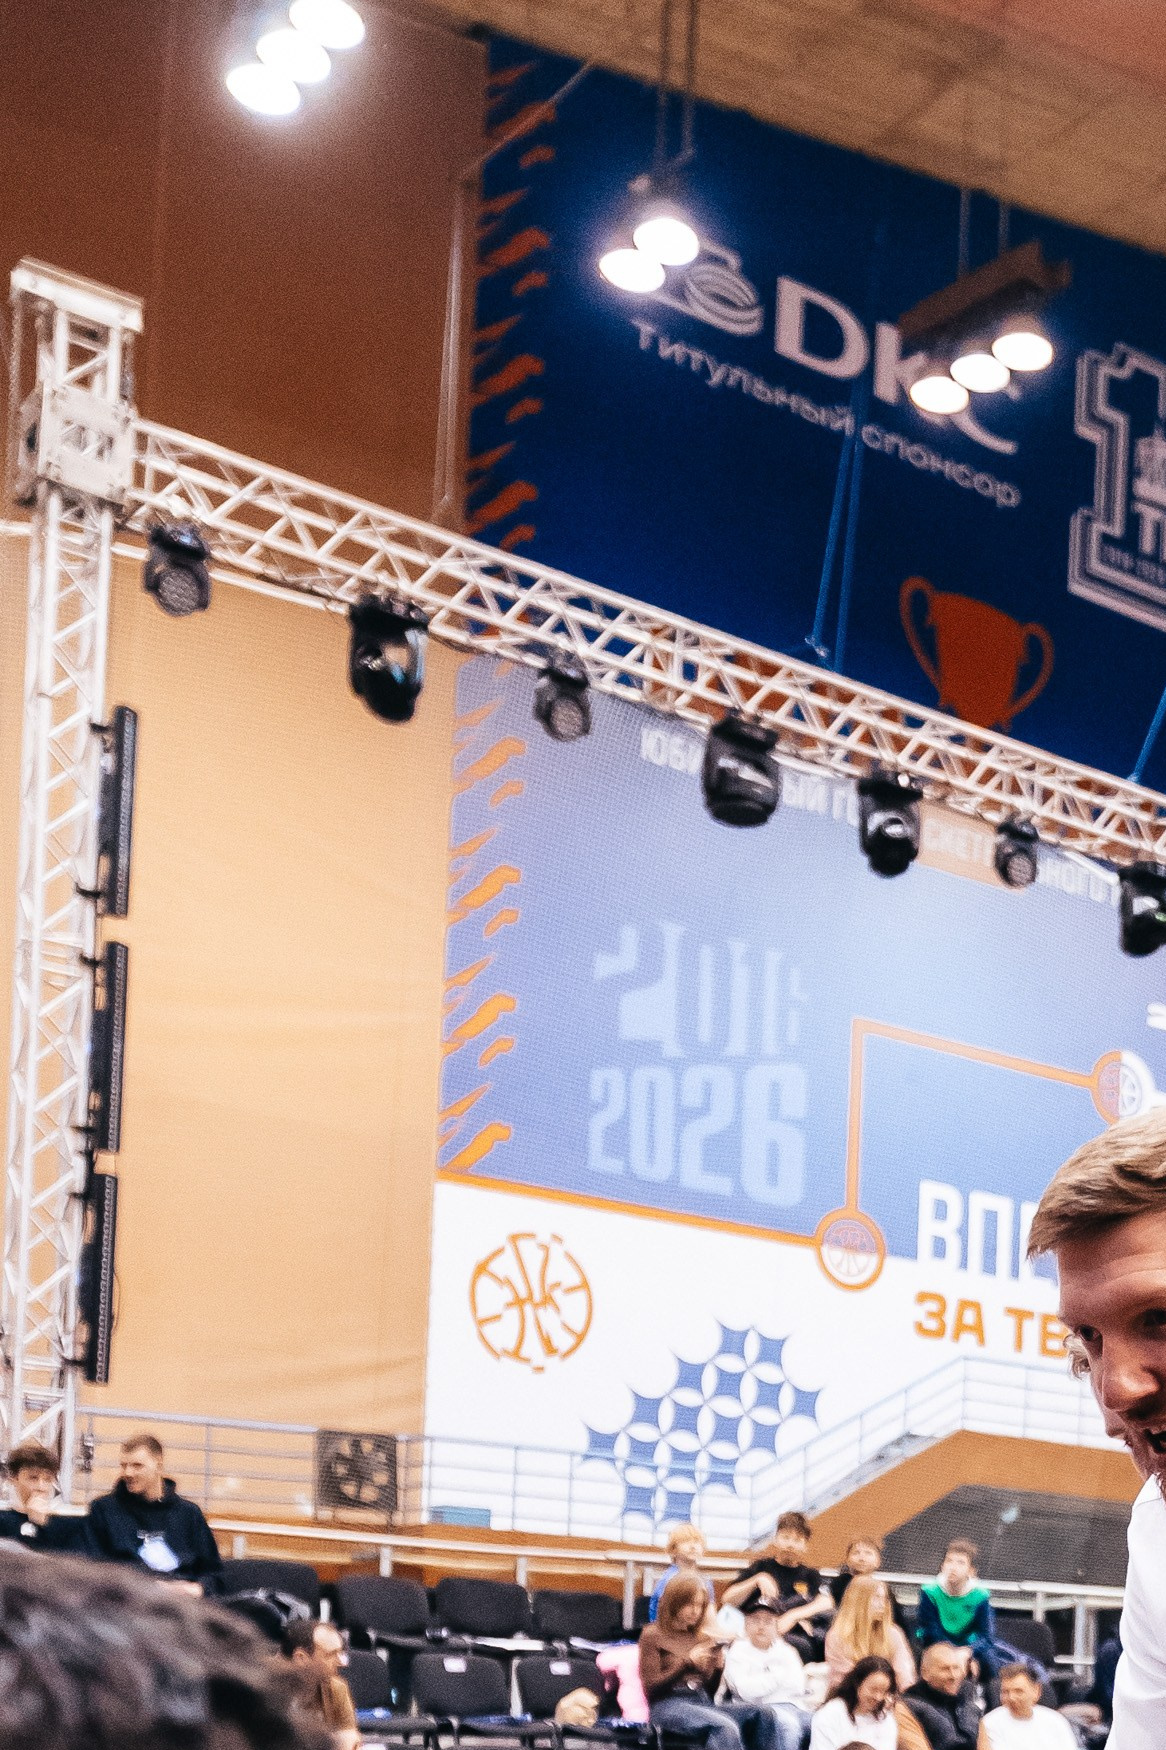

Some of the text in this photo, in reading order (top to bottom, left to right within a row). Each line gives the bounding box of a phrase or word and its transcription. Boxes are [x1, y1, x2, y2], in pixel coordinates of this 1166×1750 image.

[631, 317, 1022, 509] Титульный спонсор
[588, 1063, 806, 1207] 2026
[914, 1290, 986, 1347] ЗА
